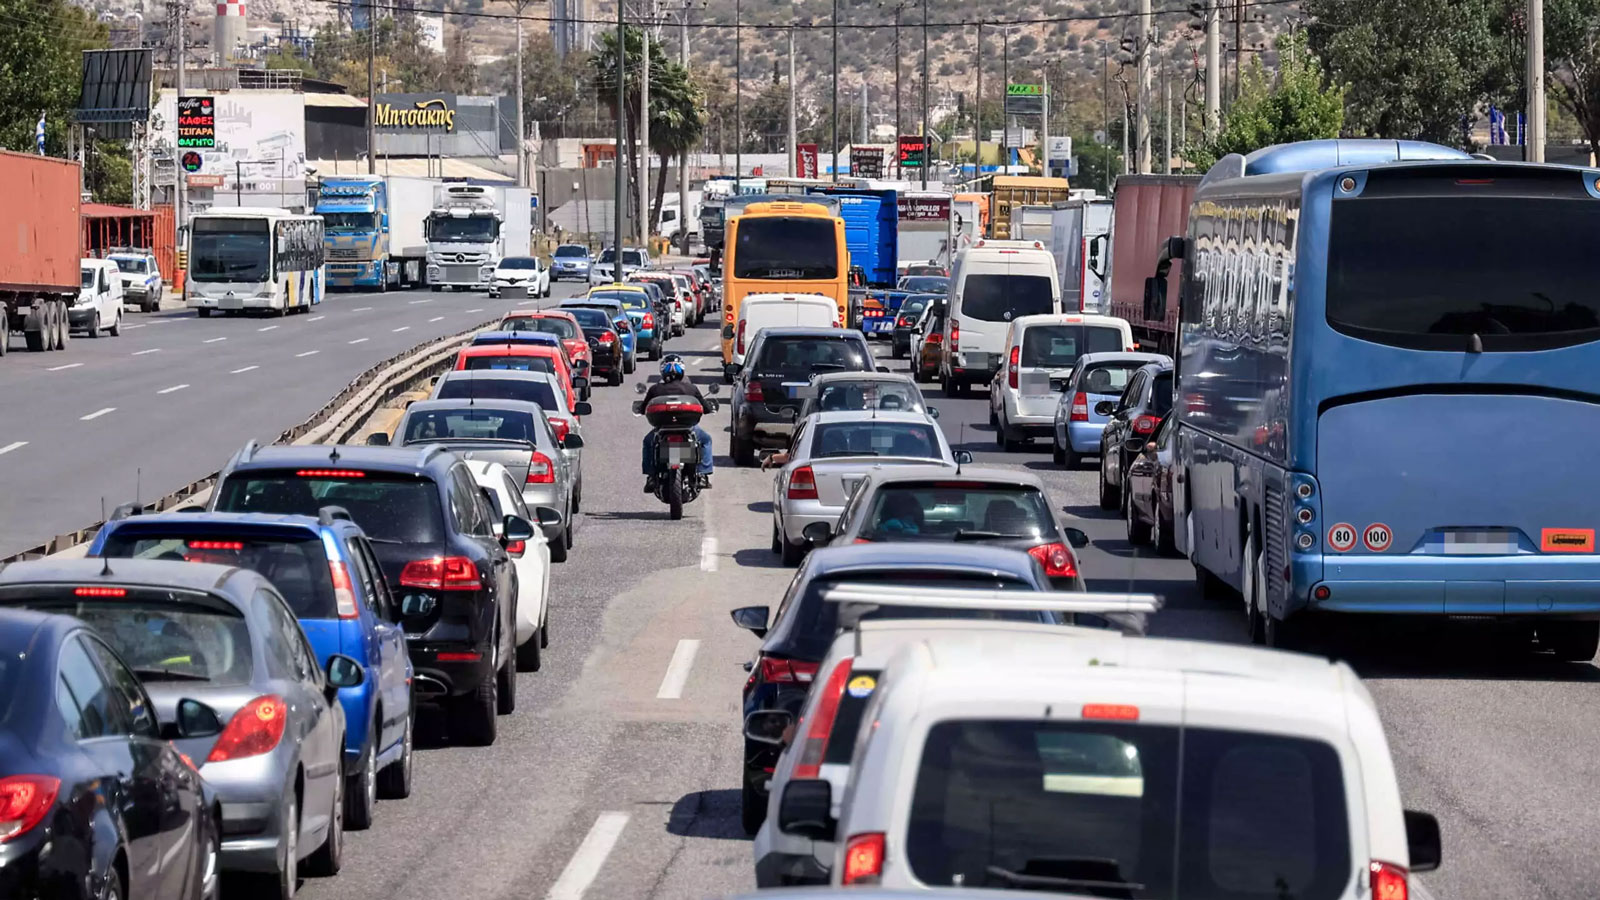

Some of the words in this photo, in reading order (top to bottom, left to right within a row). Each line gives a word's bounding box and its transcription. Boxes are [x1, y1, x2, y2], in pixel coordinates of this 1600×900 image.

[178, 98, 200, 109] coffee
[374, 99, 455, 130] Μητσάκης
[179, 116, 214, 125] ΚΑΦΕΣ
[178, 127, 213, 136] ΤΣΙΓΑΡΑ
[178, 138, 214, 146] ΦΑΓΗΤΟ
[184, 153, 199, 164] 24
[1335, 530, 1350, 542] 80
[1369, 531, 1387, 543] 100
